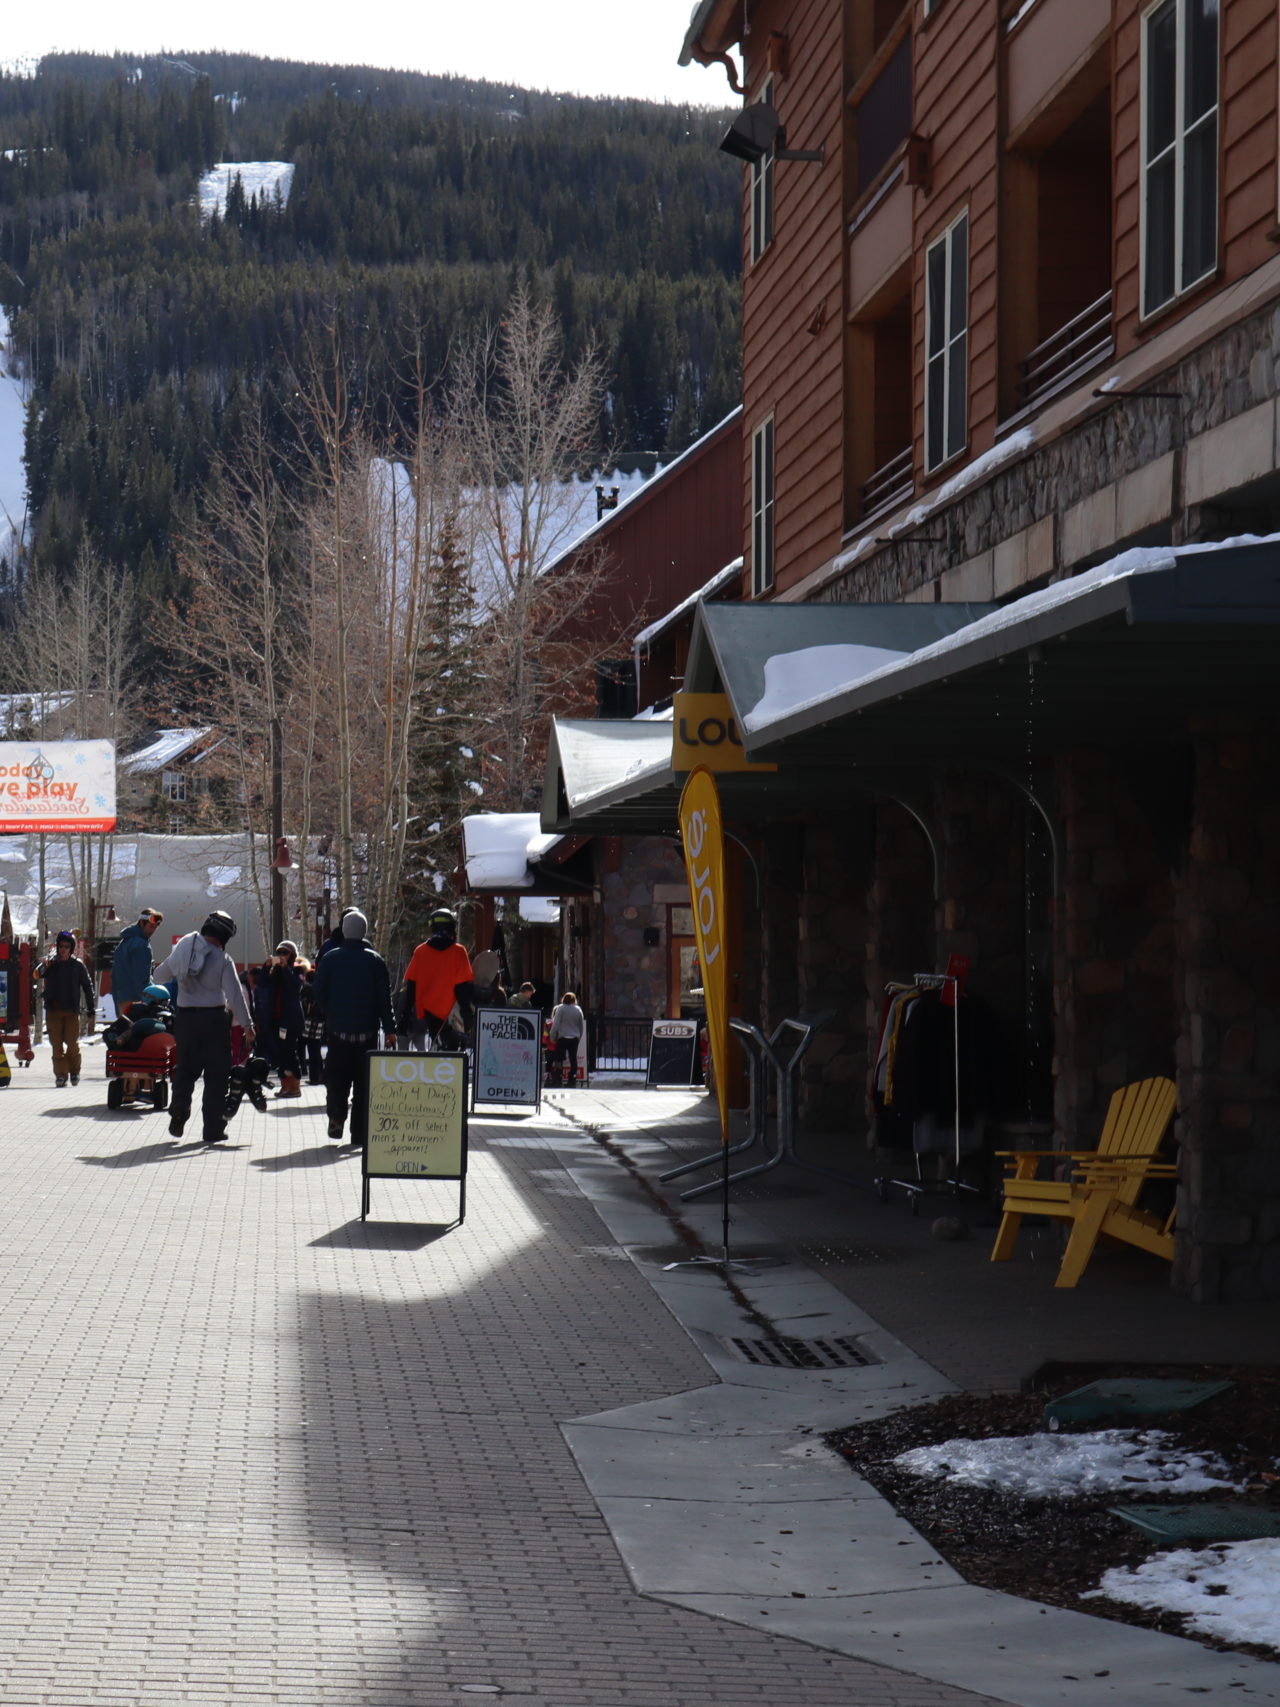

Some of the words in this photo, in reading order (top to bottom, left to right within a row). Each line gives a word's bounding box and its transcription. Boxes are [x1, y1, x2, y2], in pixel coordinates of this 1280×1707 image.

[679, 717, 741, 746] LOL
[27, 778, 79, 801] play
[498, 1015, 517, 1024] THE
[482, 1022, 517, 1032] NORTH
[660, 1026, 688, 1036] SUBS
[491, 1031, 517, 1040] FACE
[380, 1085, 408, 1101] Only
[411, 1087, 420, 1101] 4
[487, 1087, 519, 1098] OPEN
[375, 1117, 399, 1132] 30%
[405, 1119, 420, 1131] off
[426, 1121, 448, 1132] select
[395, 1161, 419, 1174] OPEN
